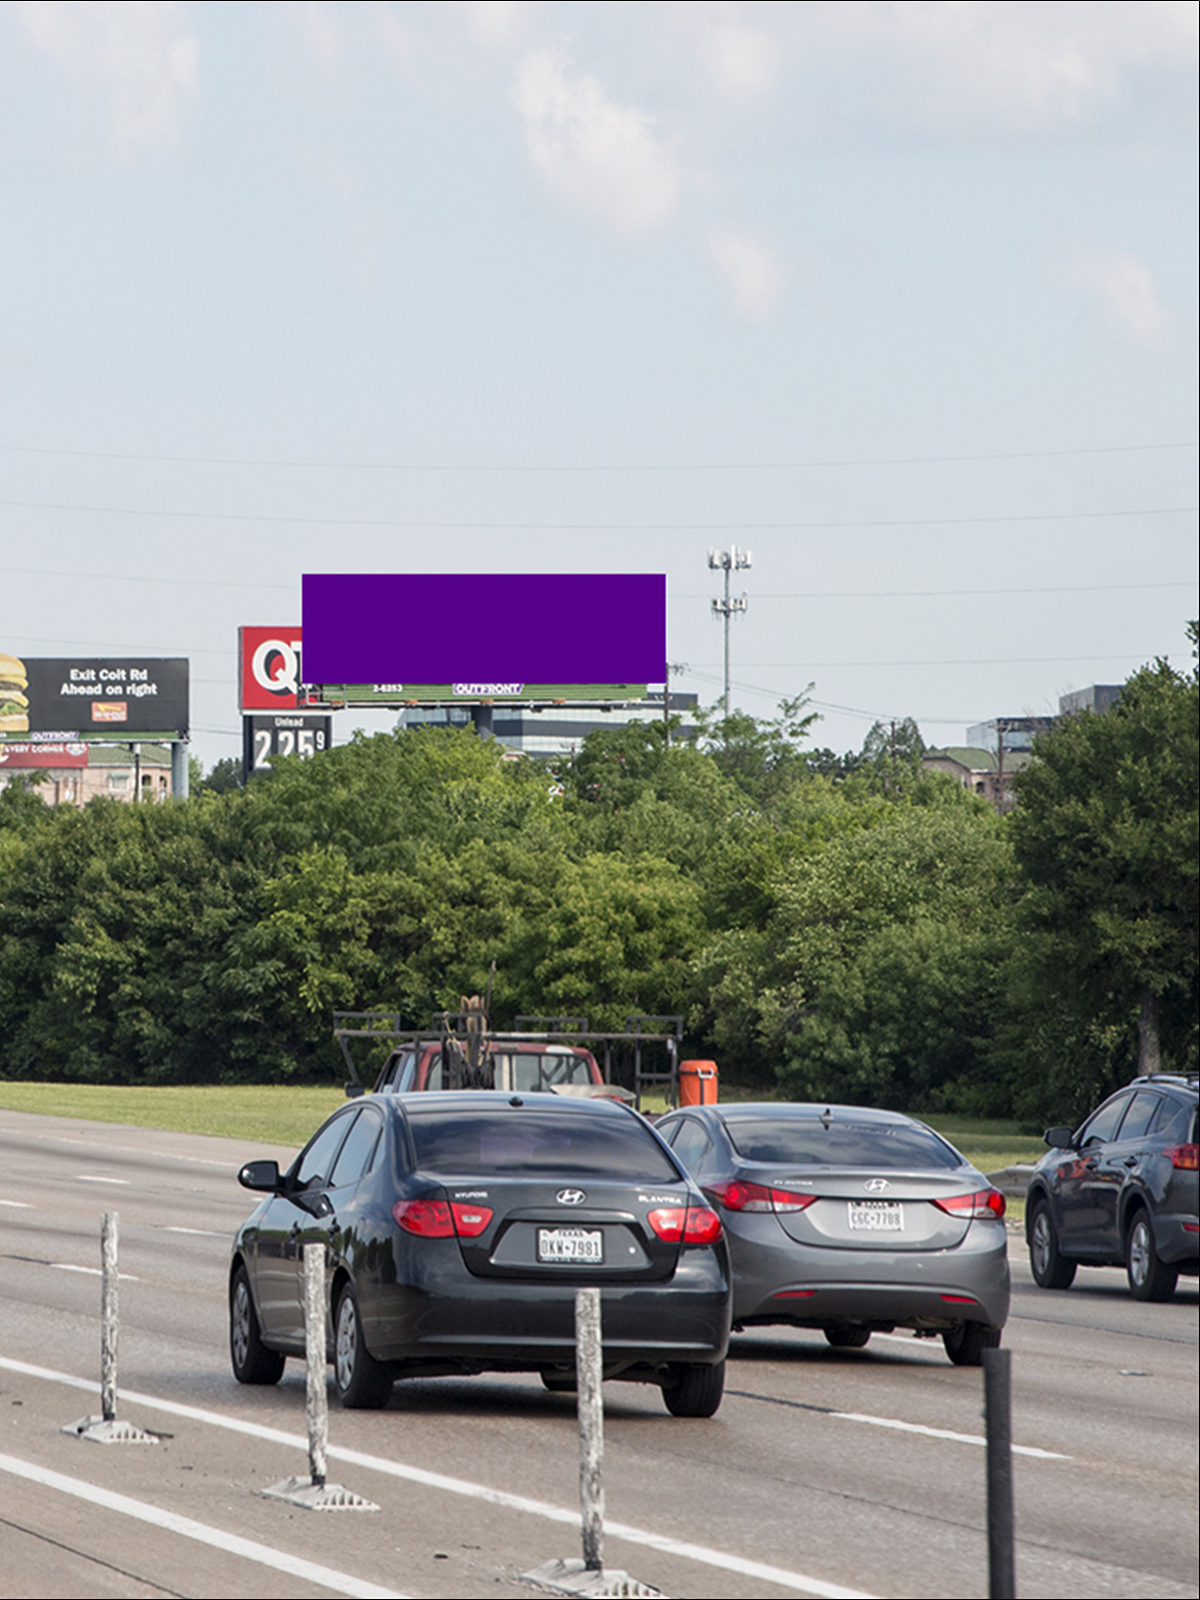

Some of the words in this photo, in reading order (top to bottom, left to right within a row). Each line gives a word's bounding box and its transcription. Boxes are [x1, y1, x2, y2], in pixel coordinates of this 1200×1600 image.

[251, 639, 302, 695] Q
[70, 668, 96, 681] Exit
[99, 668, 127, 681] Coit
[129, 668, 148, 681] Rd
[60, 682, 102, 695] Ahead
[105, 685, 123, 695] on
[126, 682, 158, 698] right
[454, 683, 522, 694] OUTFRONT
[275, 717, 303, 727] Unlead
[31, 744, 64, 753] CORNER
[638, 1194, 682, 1204] ELANTRA
[557, 1229, 583, 1237] TEXAS
